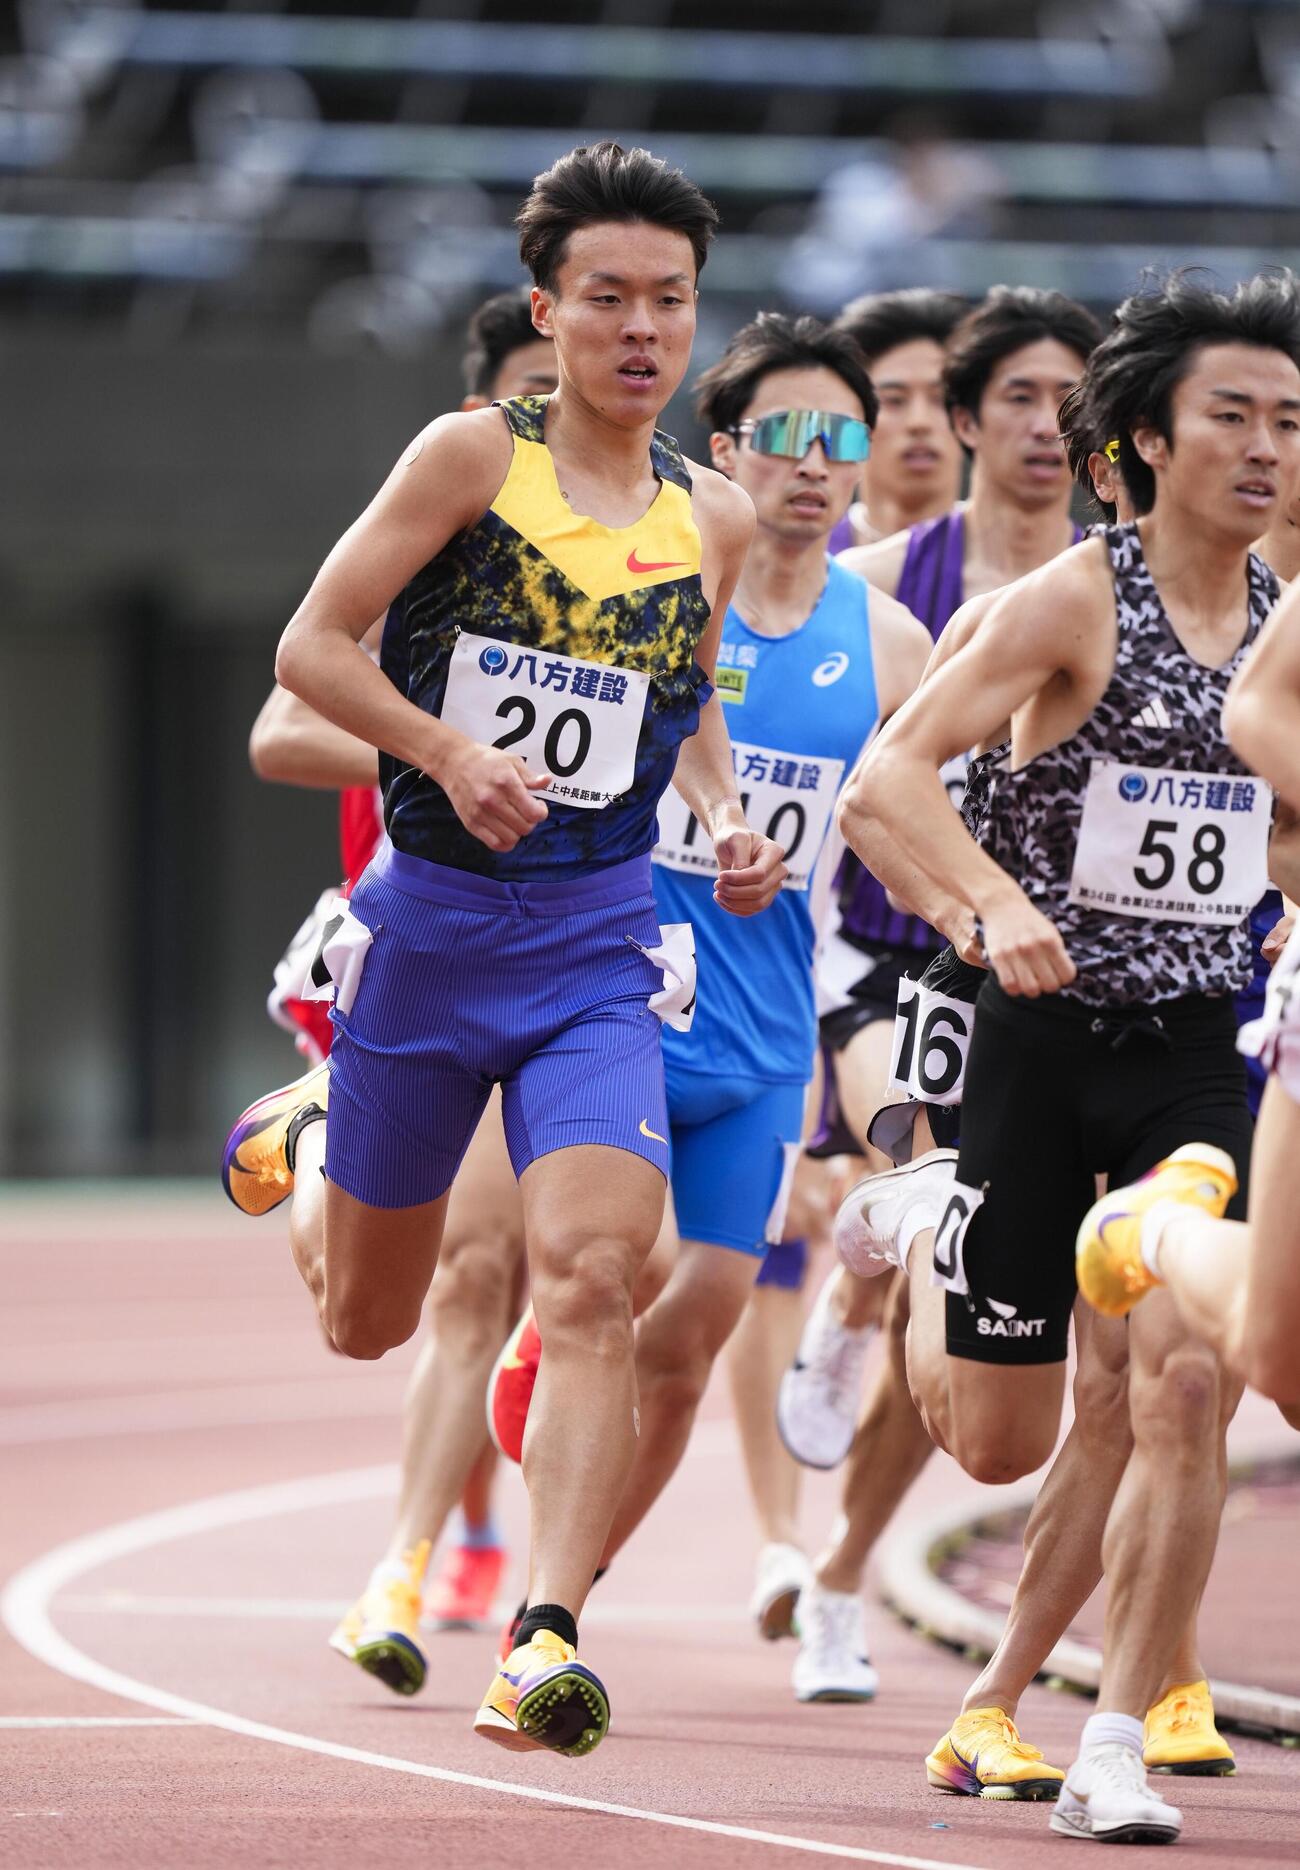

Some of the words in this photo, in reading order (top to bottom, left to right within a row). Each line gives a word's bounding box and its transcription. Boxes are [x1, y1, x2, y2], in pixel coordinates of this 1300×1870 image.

[509, 654, 628, 705] 八方建設
[492, 695, 591, 777] 20
[543, 782, 622, 803] 上中長距離大
[1150, 776, 1256, 813] 八方建設
[1133, 820, 1226, 895] 58
[895, 992, 967, 1094] 16
[977, 1317, 1046, 1337] SAINT
